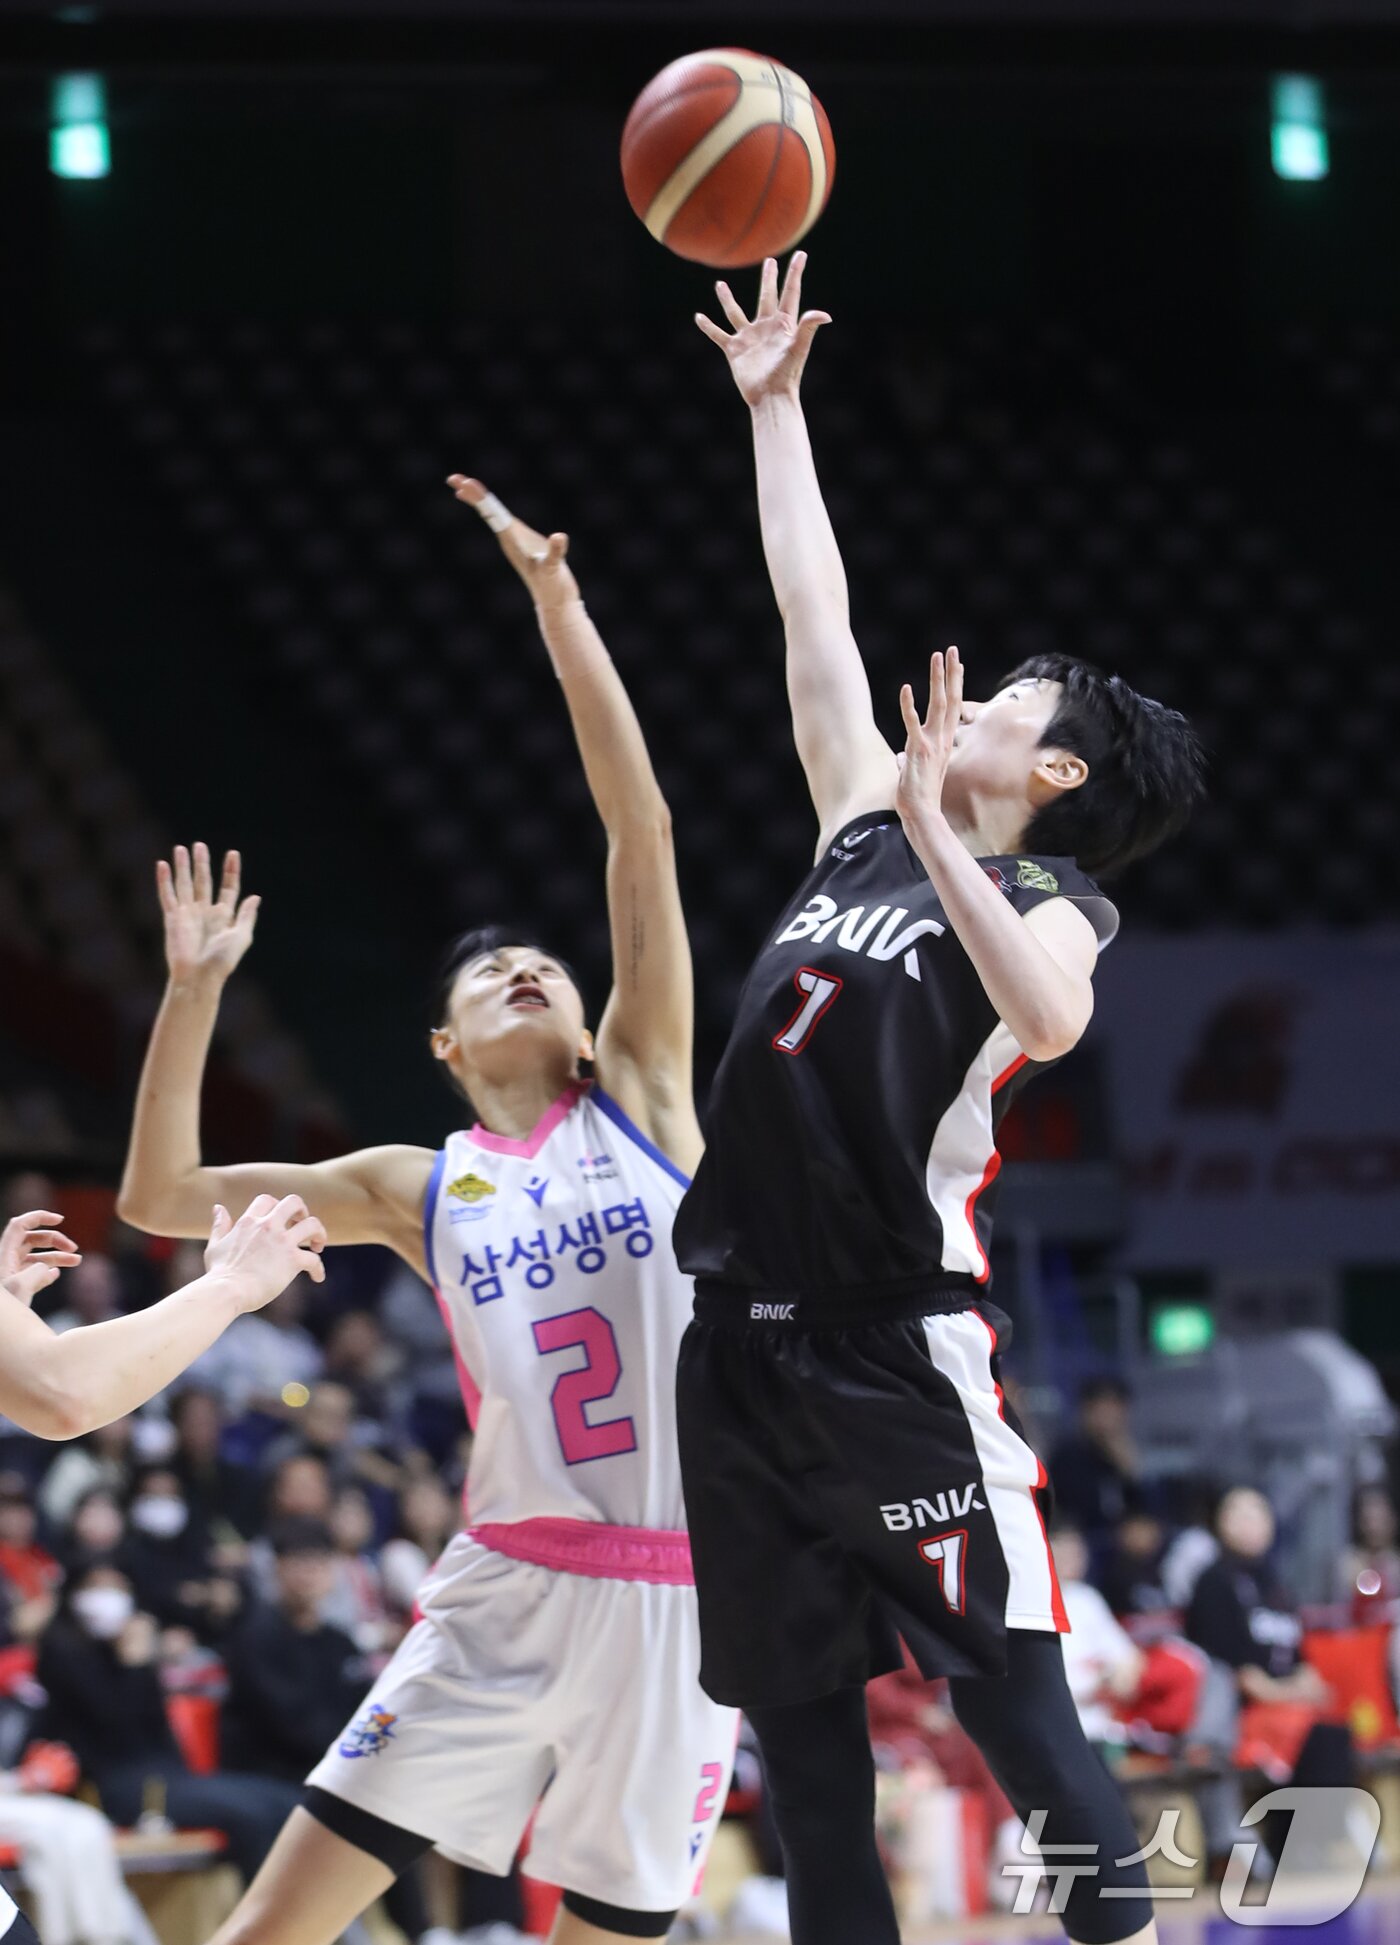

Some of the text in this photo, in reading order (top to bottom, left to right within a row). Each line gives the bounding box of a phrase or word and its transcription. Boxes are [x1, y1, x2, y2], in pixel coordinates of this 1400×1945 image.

[775, 894, 946, 983] BNK
[460, 1198, 654, 1306] 삼성생명
[751, 1303, 795, 1320] BNK
[532, 1306, 638, 1466] 2
[880, 1483, 986, 1531] BNK
[691, 1761, 723, 1824] 2
